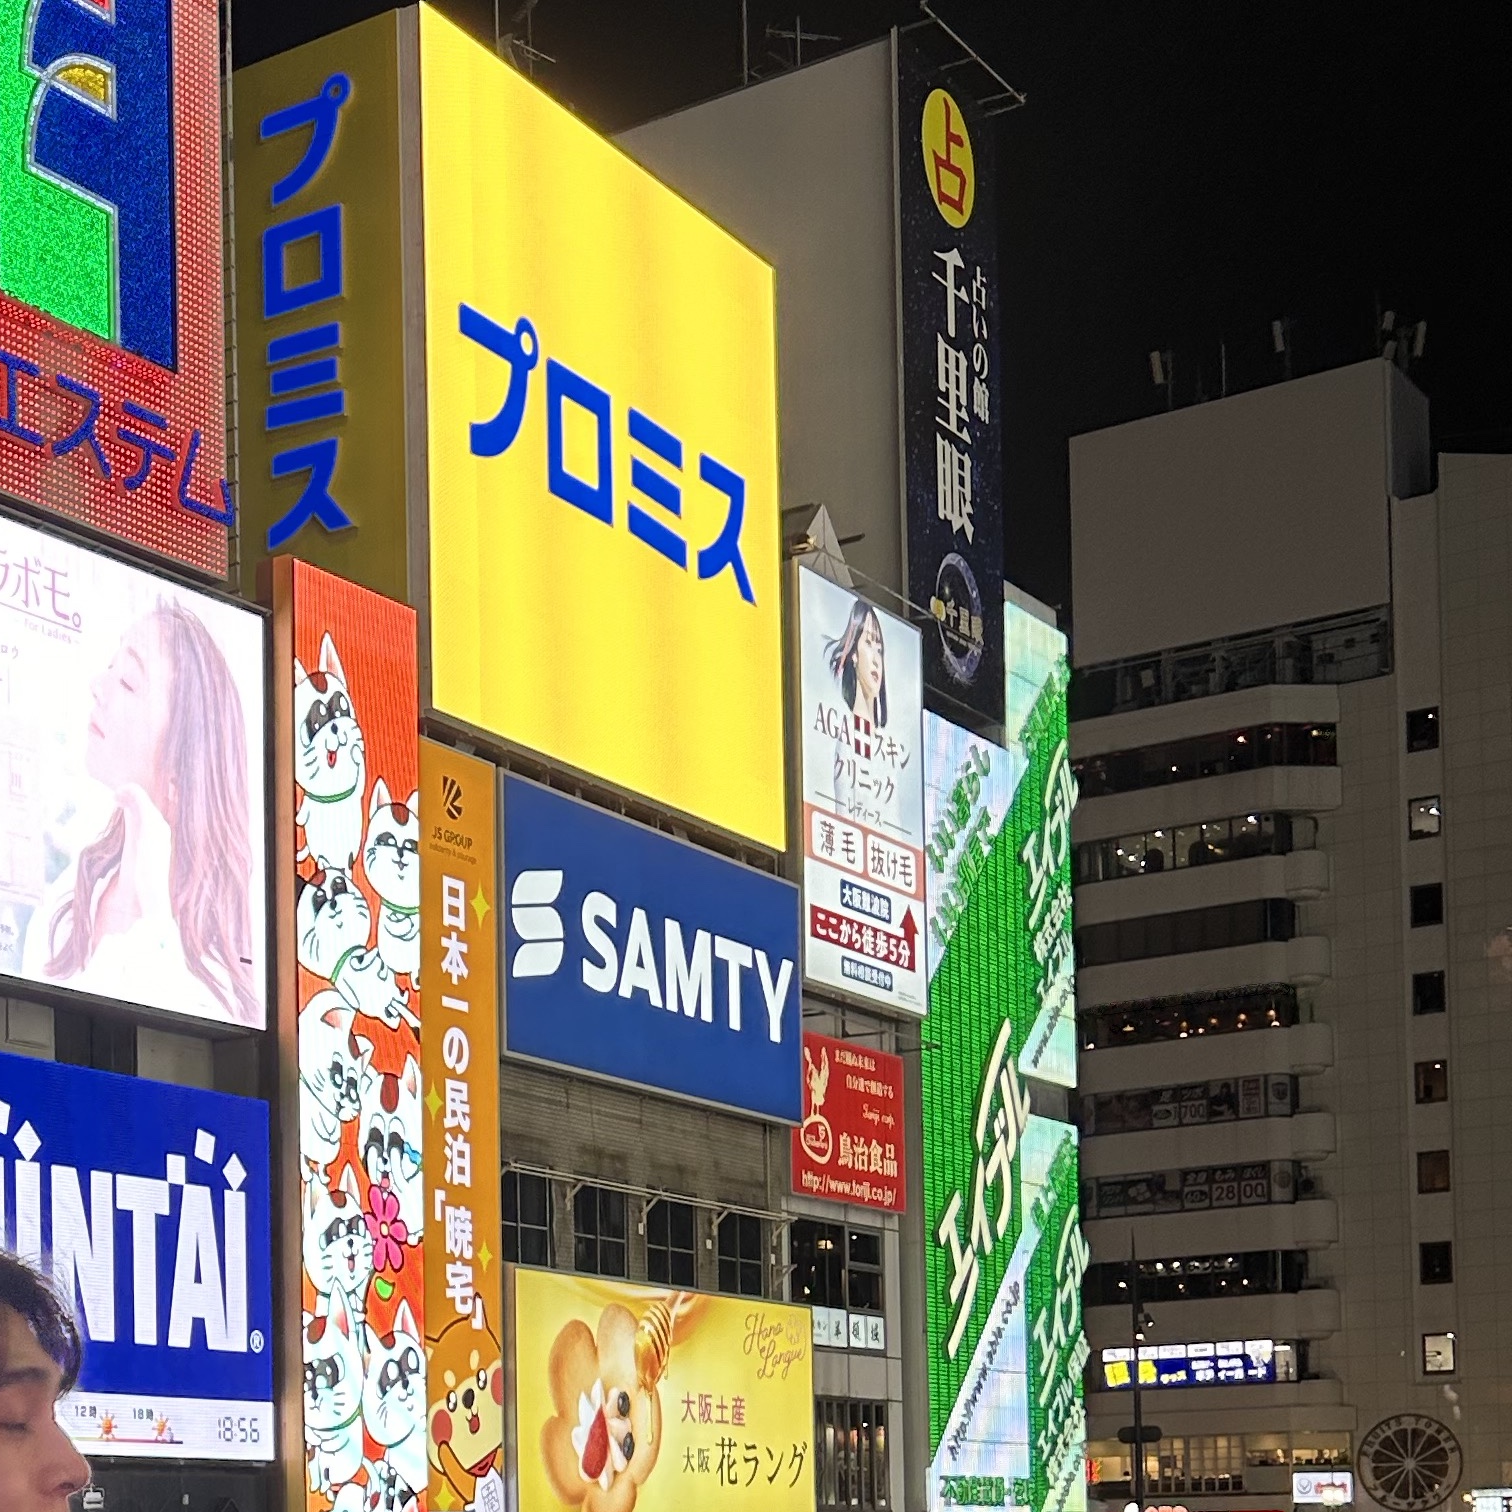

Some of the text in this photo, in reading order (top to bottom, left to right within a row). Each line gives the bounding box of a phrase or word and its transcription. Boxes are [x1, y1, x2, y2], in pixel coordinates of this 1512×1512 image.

[932, 97, 968, 217] 占
[260, 72, 352, 550] プロミス
[931, 247, 974, 546] 千里眼
[458, 301, 757, 607] プロミス
[814, 701, 910, 770] AGA スキン
[834, 752, 895, 805] クリニック
[870, 840, 913, 888] 抜け毛
[581, 890, 795, 1045] SAMTY
[815, 910, 912, 969] ここから徒歩5分
[937, 1016, 1032, 1361] エイブル
[217, 1416, 260, 1443] 18:56
[681, 1391, 746, 1427] 大阪土産
[715, 1436, 809, 1489] 花ラング
